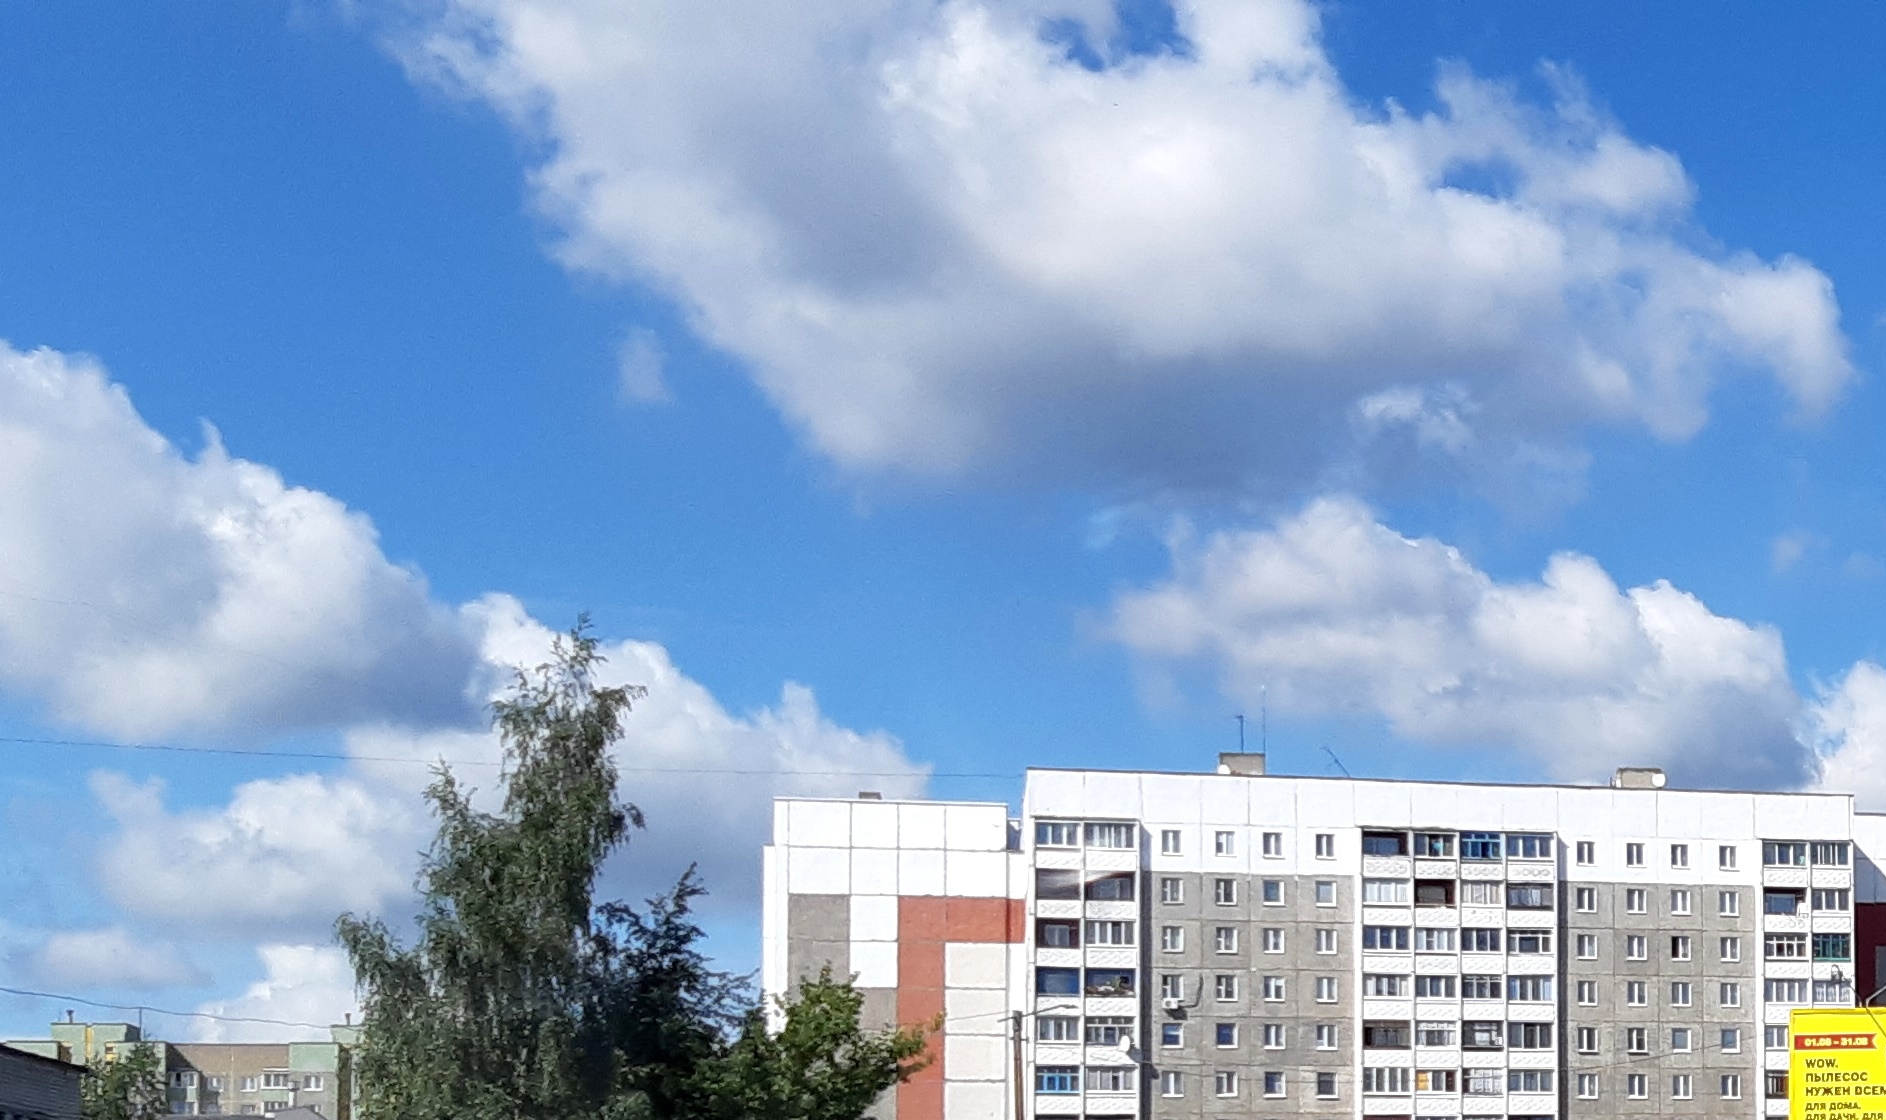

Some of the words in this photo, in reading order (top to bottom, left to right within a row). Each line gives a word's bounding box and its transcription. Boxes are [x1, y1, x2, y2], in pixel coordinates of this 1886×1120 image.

[1805, 1058, 1838, 1068] WOW.
[1805, 1072, 1868, 1082] ПЫЛЕСОС
[1805, 1086, 1851, 1096] НУЖЕН
[1805, 1102, 1826, 1111] ДЛЯ
[1829, 1102, 1861, 1111] ДОМА.
[1862, 1112, 1883, 1120] ДЛЯ
